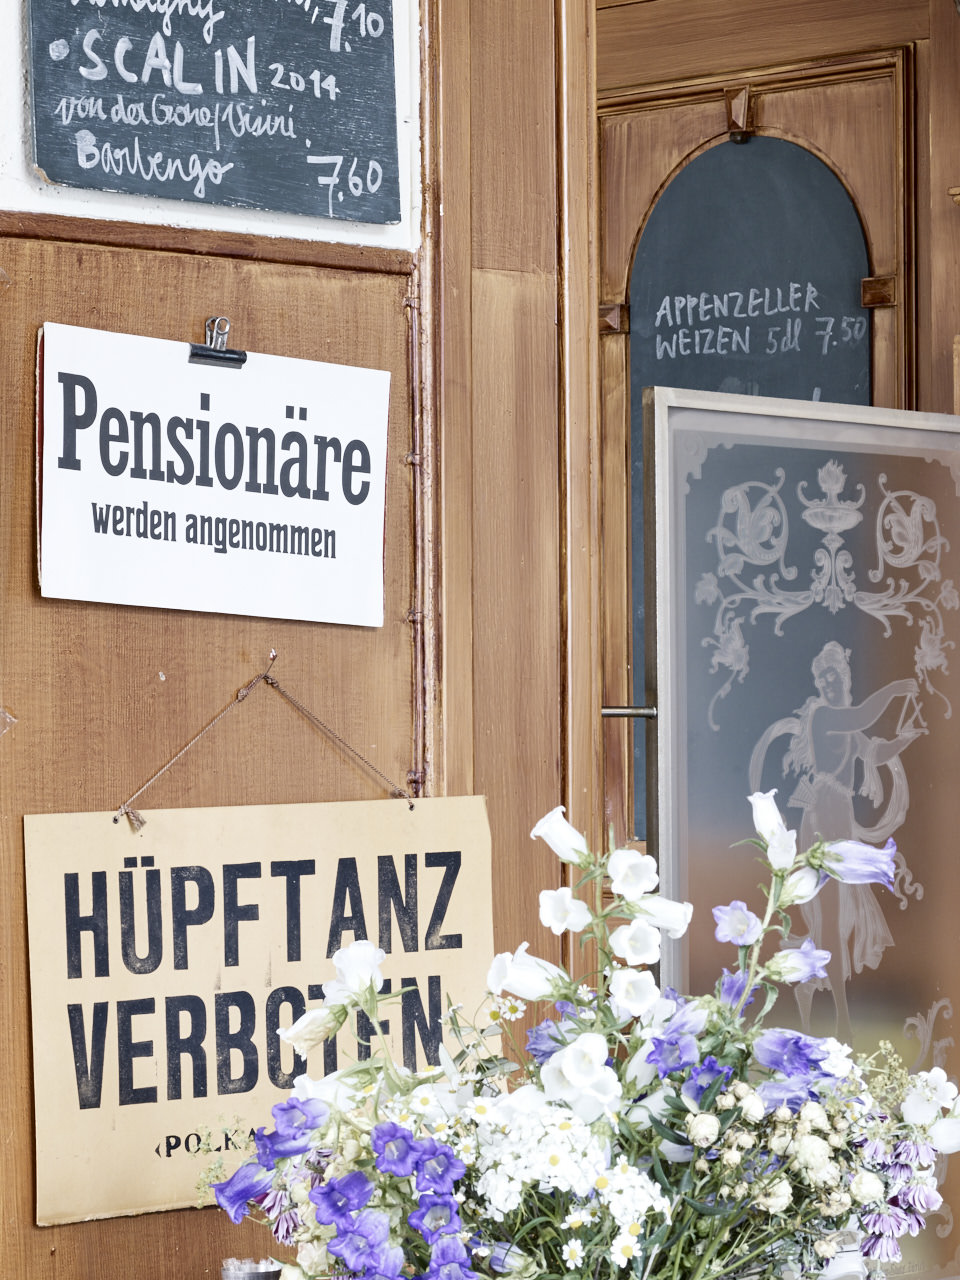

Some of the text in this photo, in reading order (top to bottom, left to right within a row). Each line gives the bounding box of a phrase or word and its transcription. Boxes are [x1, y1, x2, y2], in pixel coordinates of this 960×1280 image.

[267, 63, 341, 101] 2014
[306, 154, 383, 218] 7.60
[654, 281, 821, 327] APPENZELLER
[656, 325, 750, 360] WEIZEN
[815, 315, 867, 355] 7.50
[57, 371, 372, 506] Pensionäre
[91, 500, 337, 560] werden angenommen
[63, 850, 464, 980] HÜPFTANZ
